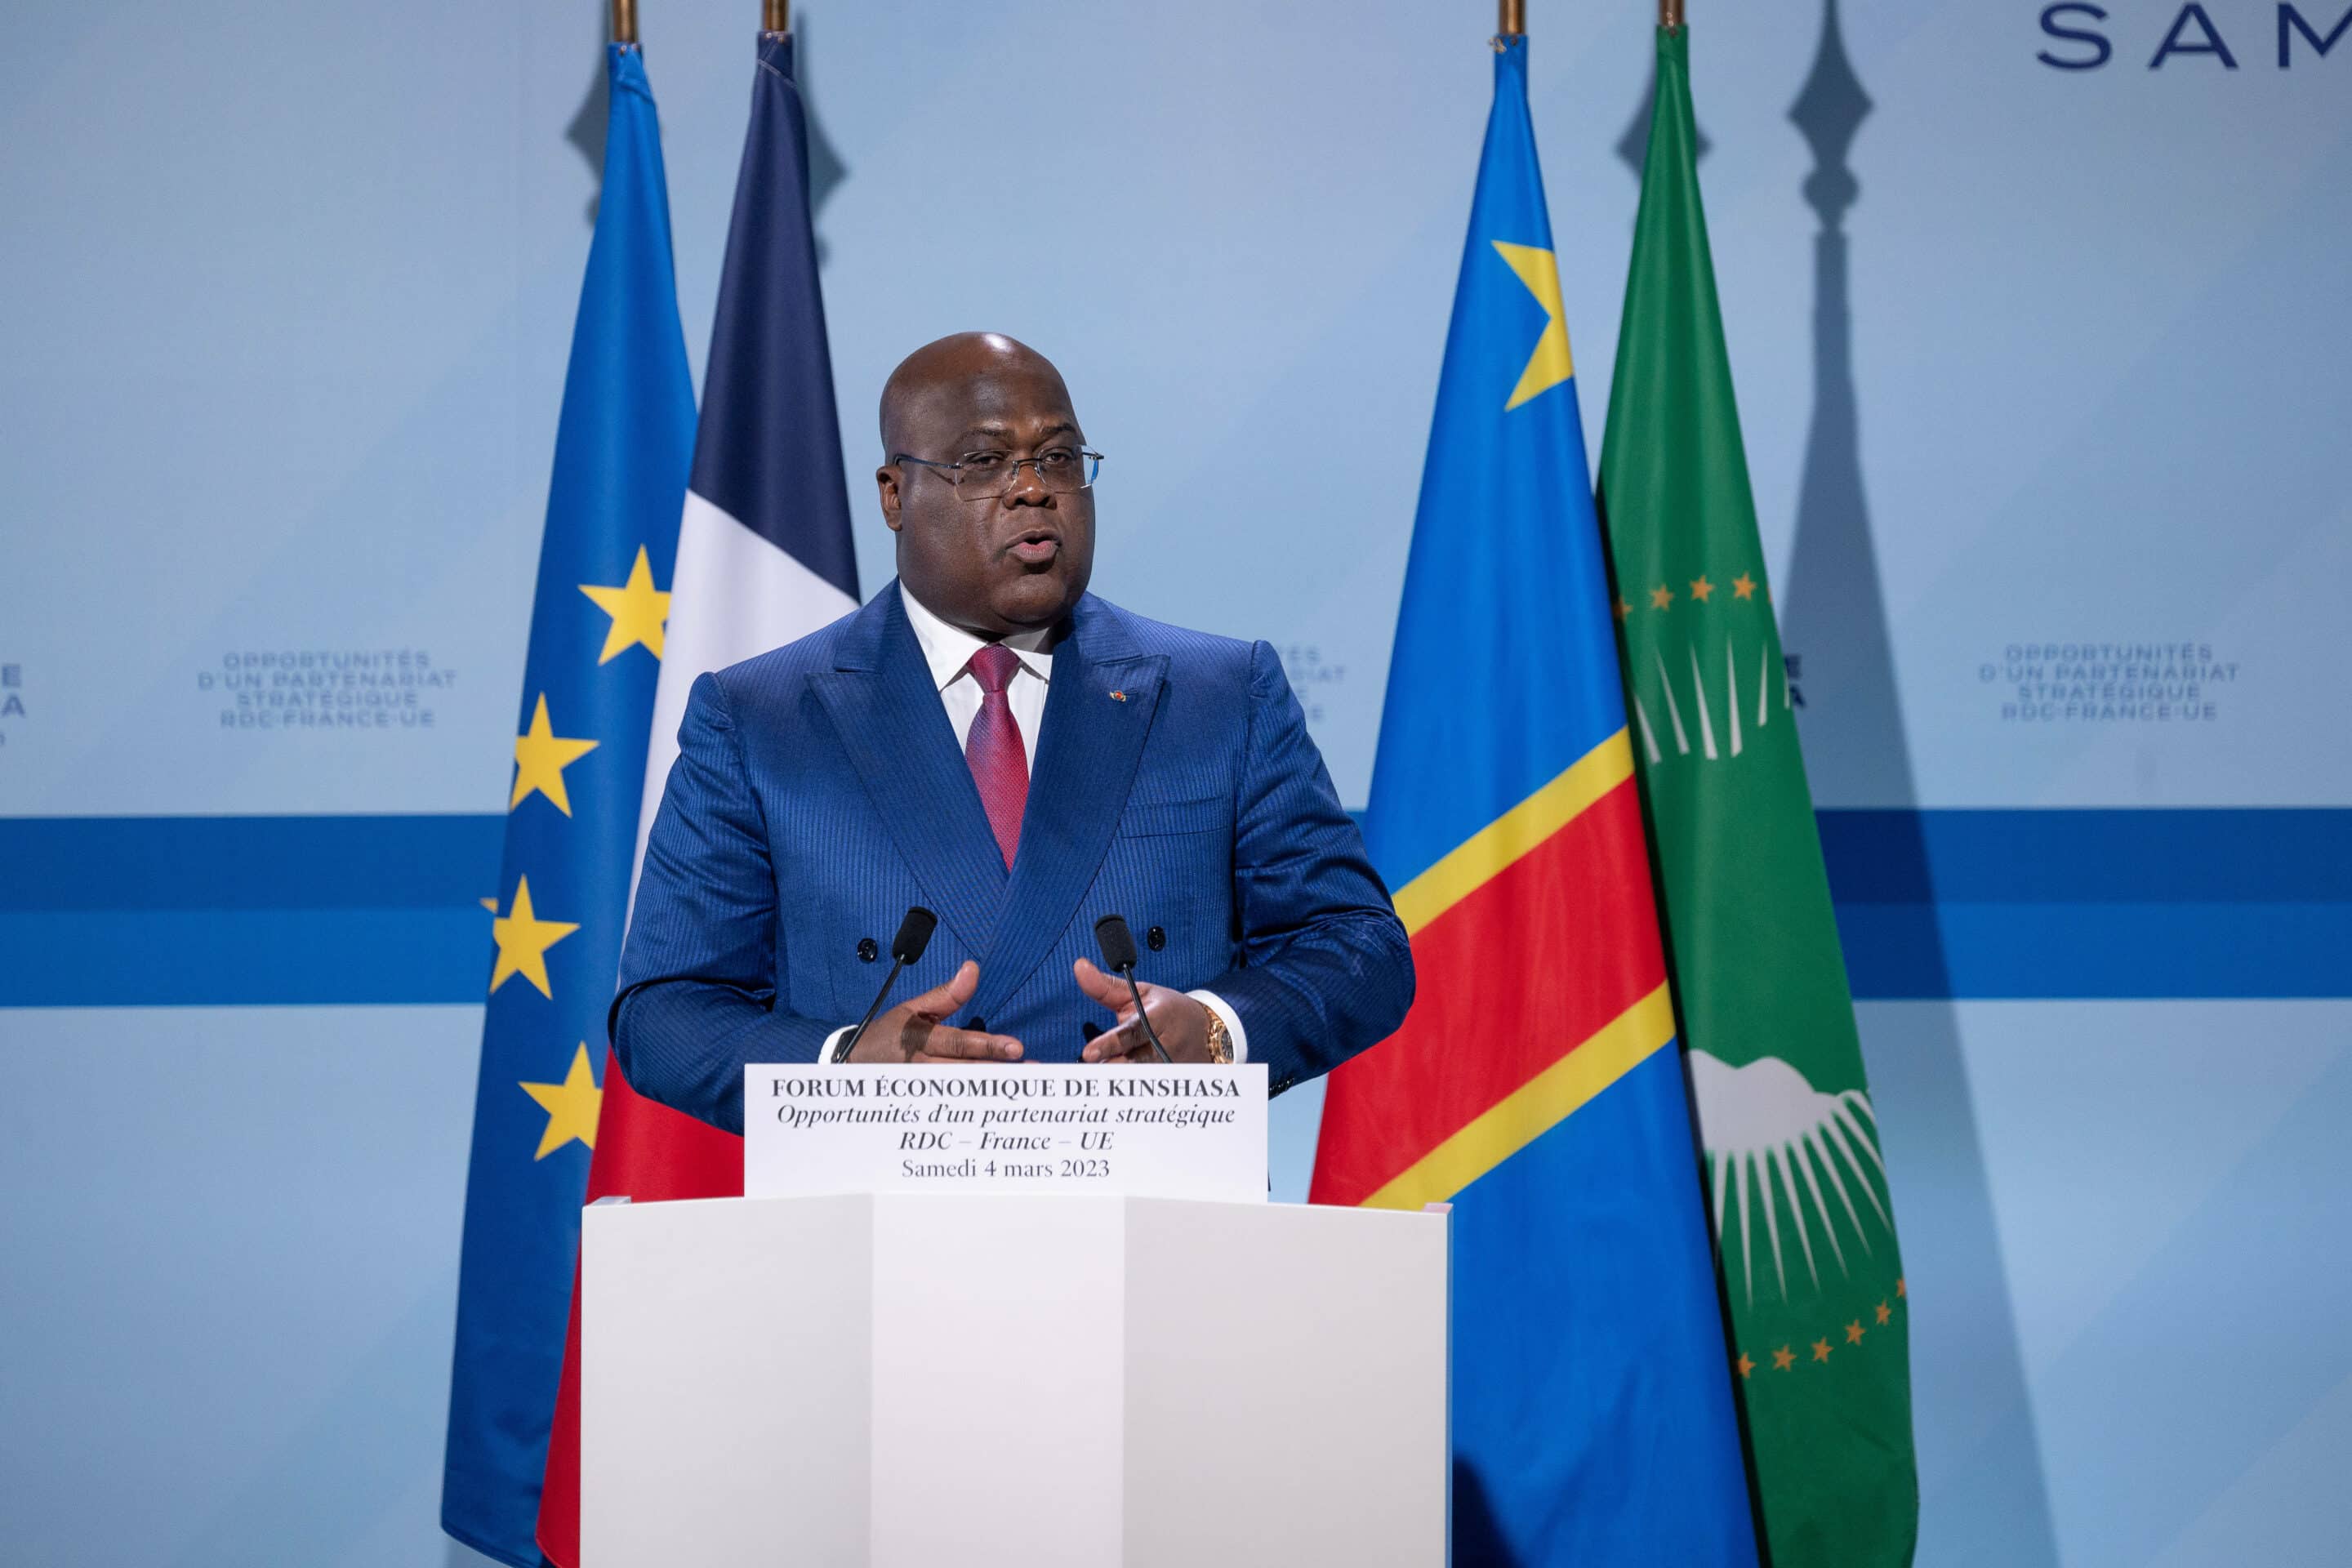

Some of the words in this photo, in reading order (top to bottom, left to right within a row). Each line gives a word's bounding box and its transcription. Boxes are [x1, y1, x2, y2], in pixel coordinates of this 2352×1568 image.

[222, 646, 430, 669] OPPORTUNITÉS
[2005, 639, 2213, 662] OPPORTUNITÉS
[273, 669, 457, 688] PARTENARIAT
[2056, 662, 2240, 682] PARTENARIAT
[237, 689, 418, 709] STRATÉGIQUE
[2018, 681, 2201, 701] STRATÉGIQUE
[771, 1079, 866, 1098] FORUM
[875, 1075, 1056, 1100] ÉCONOMIQUE
[1064, 1079, 1099, 1097] DE
[1107, 1079, 1241, 1098] KINSHASA
[777, 1103, 920, 1129] Opportunités
[980, 1103, 1108, 1129] partenariat
[1115, 1103, 1236, 1129] stratégique
[898, 1131, 953, 1151] RDC
[978, 1131, 1051, 1151] France
[1080, 1131, 1115, 1151] UE
[902, 1158, 976, 1177] Samedi
[984, 1160, 997, 1177] 4
[1004, 1165, 1053, 1177] mars
[1061, 1160, 1110, 1177] 2023
